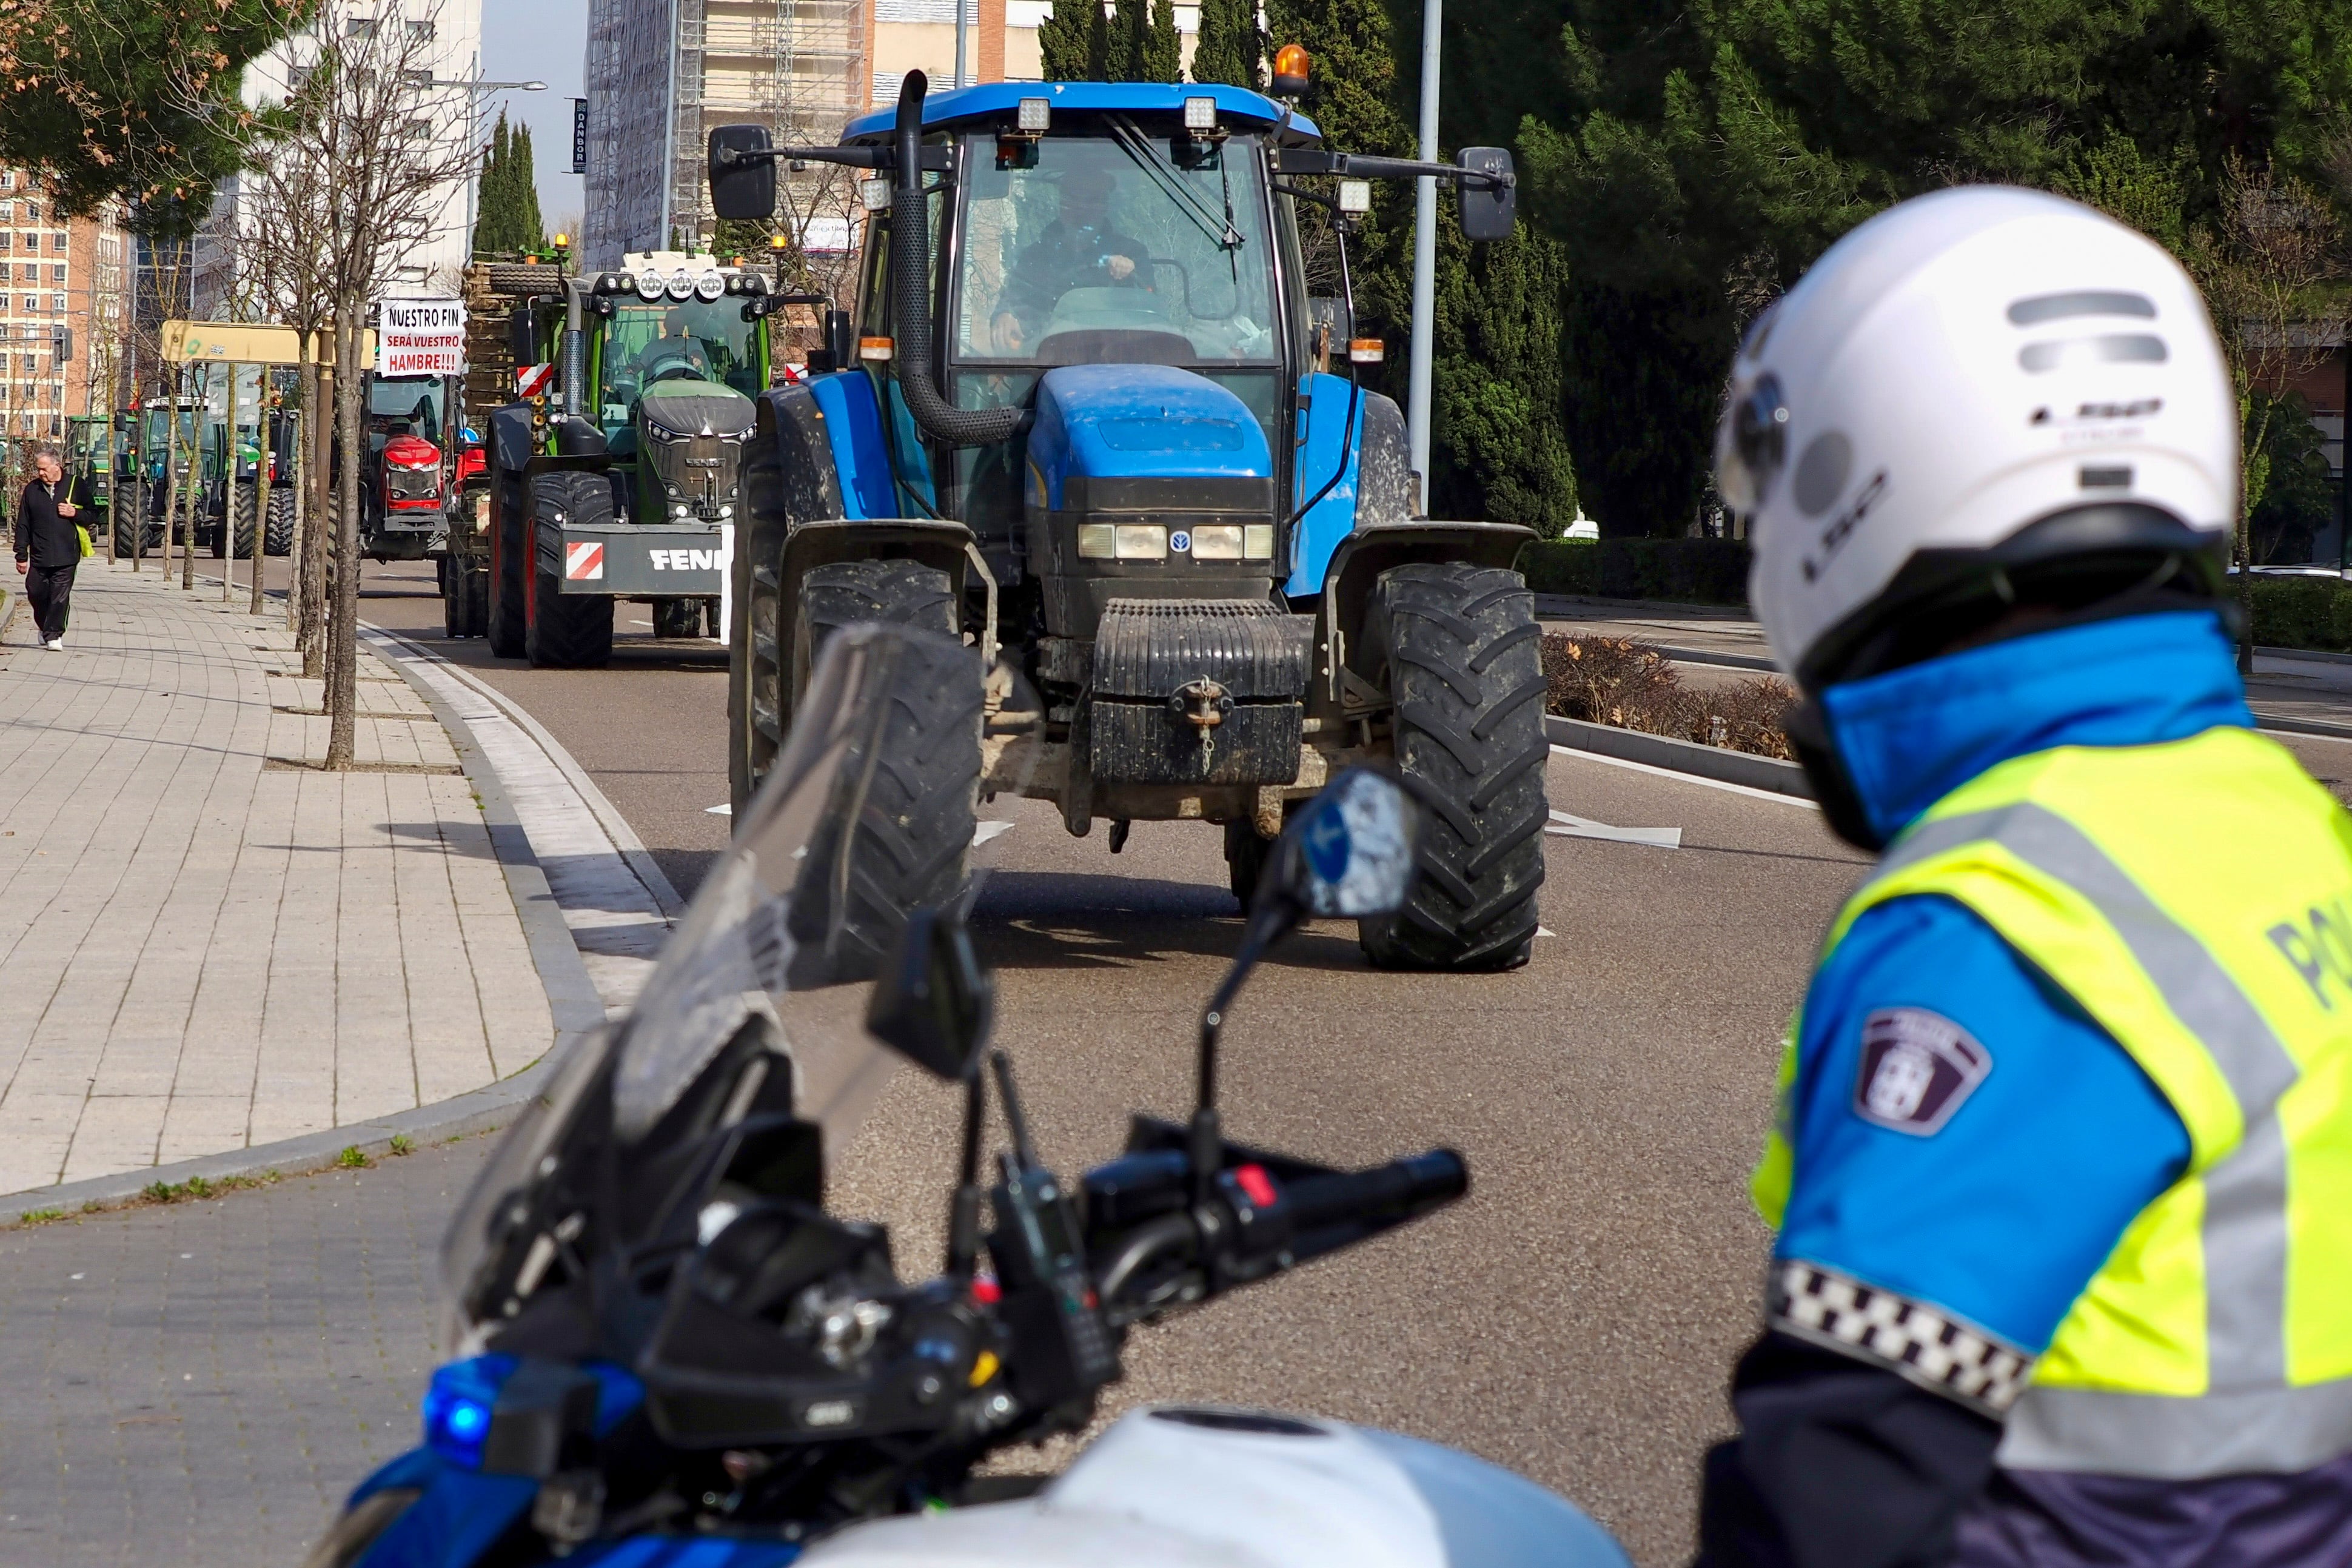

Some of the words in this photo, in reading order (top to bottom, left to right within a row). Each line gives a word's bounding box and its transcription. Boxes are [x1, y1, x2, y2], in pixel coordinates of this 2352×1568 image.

[577, 113, 585, 161] DANBOR
[389, 309, 439, 327] NUESTRO
[442, 309, 458, 327] FIN
[387, 333, 412, 347] SERÁ
[414, 335, 459, 347] VUESTRO
[389, 353, 455, 372] HAMBRE!!!
